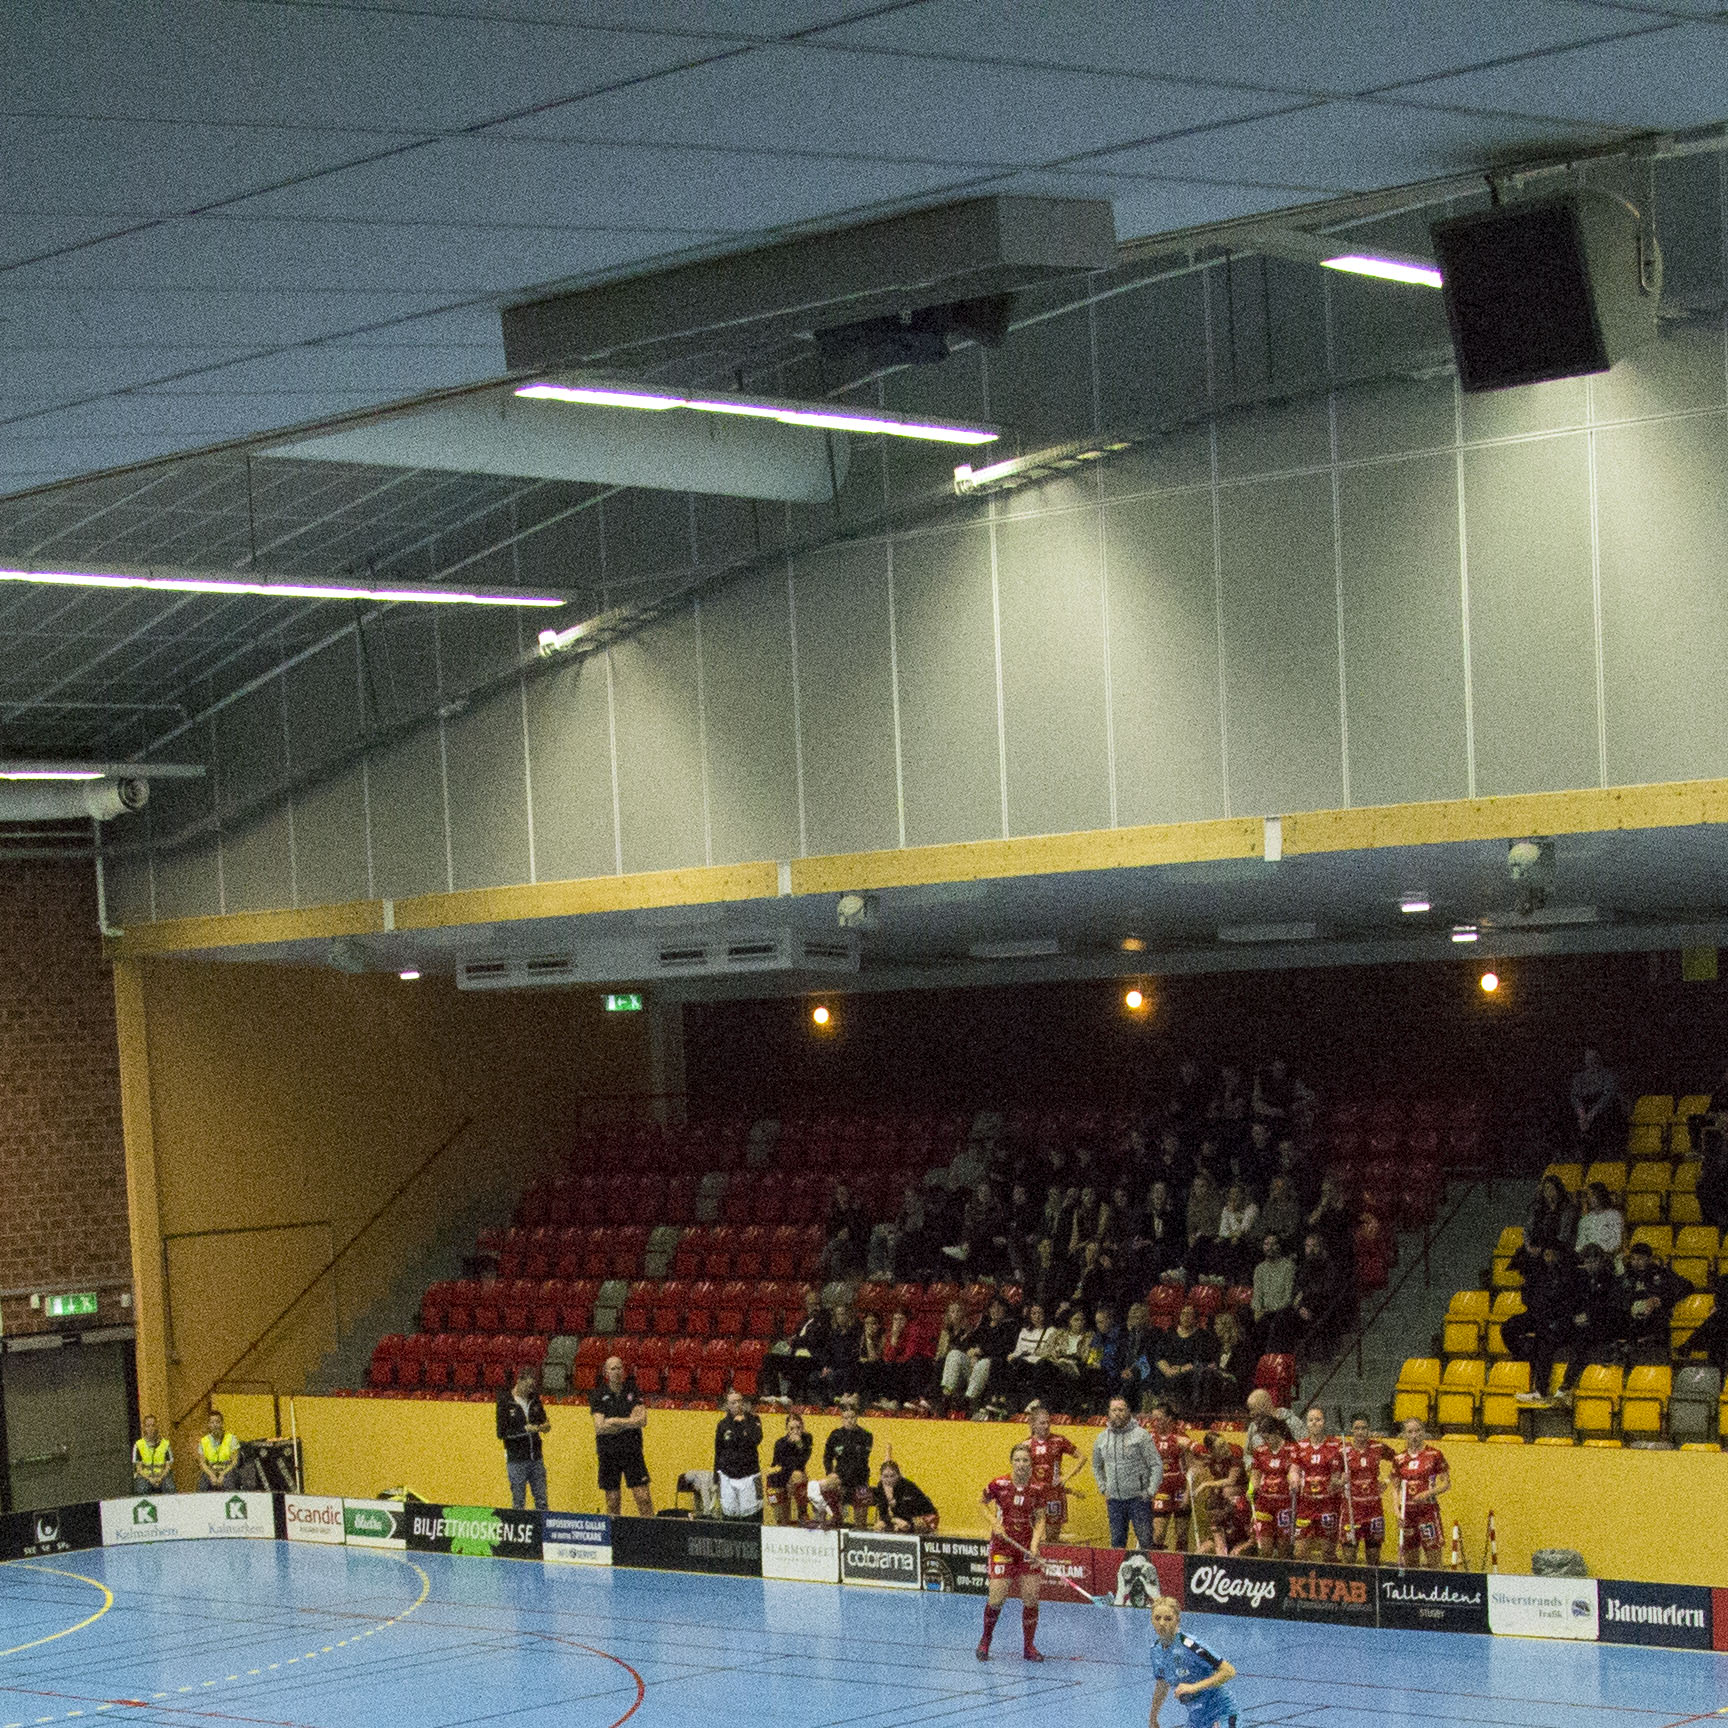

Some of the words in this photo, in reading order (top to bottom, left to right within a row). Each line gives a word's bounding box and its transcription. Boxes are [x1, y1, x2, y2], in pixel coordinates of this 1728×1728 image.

[287, 1503, 342, 1526] Scandic
[412, 1516, 535, 1545] BILJETTKIOSKEN.SE
[846, 1545, 914, 1571] colorama
[1189, 1564, 1277, 1609] O'Learys
[1491, 1592, 1563, 1607] Silverstrands
[1605, 1597, 1706, 1629] Barometern
